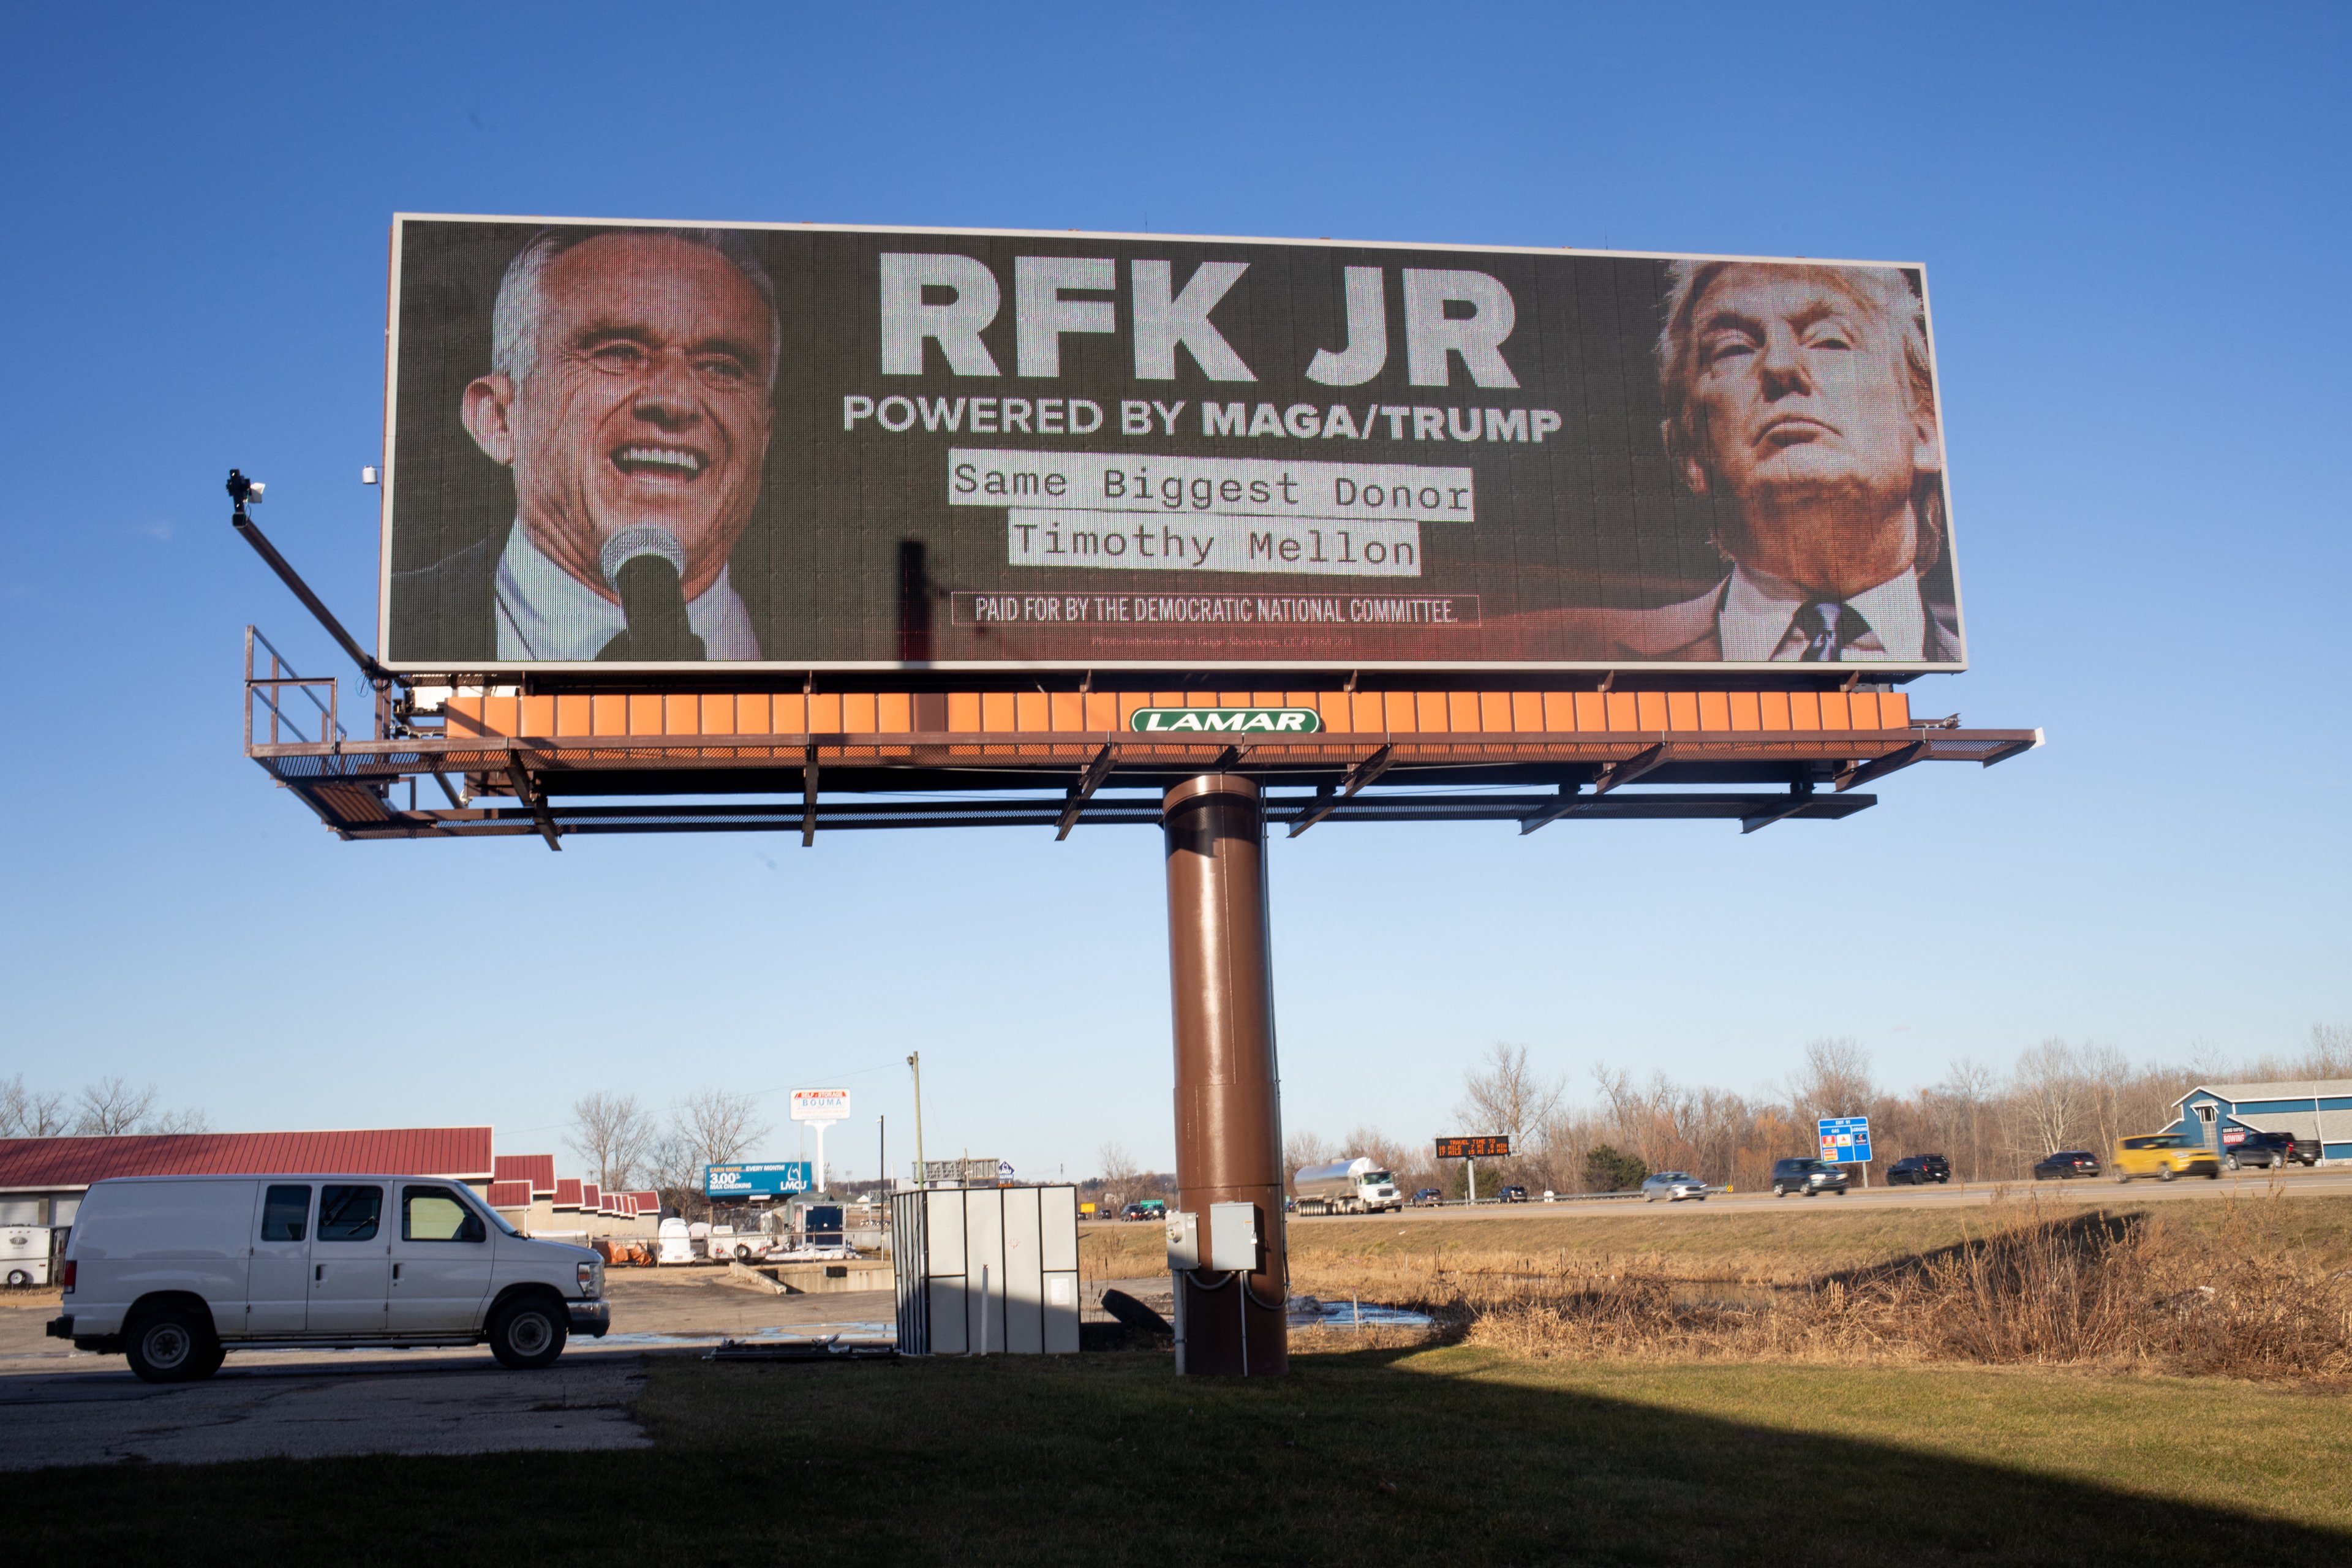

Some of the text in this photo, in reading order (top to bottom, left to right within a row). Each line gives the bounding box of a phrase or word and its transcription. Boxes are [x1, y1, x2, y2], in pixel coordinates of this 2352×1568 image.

[880, 252, 1520, 388] RFK JR
[844, 395, 1562, 442] POWERED BY MAGA/TRUMP
[954, 463, 1469, 510] Same Biggest Donor
[1014, 521, 1414, 567] Timothy Mellon
[976, 597, 1458, 623] PAID FOR BY THE DEMOCRATIC NATIONAL COMMITTEE.
[1145, 713, 1306, 731] LAMAR
[2223, 1134, 2245, 1144] ROWING
[710, 1173, 735, 1184] 3.00
[780, 1181, 807, 1190] LMCU
